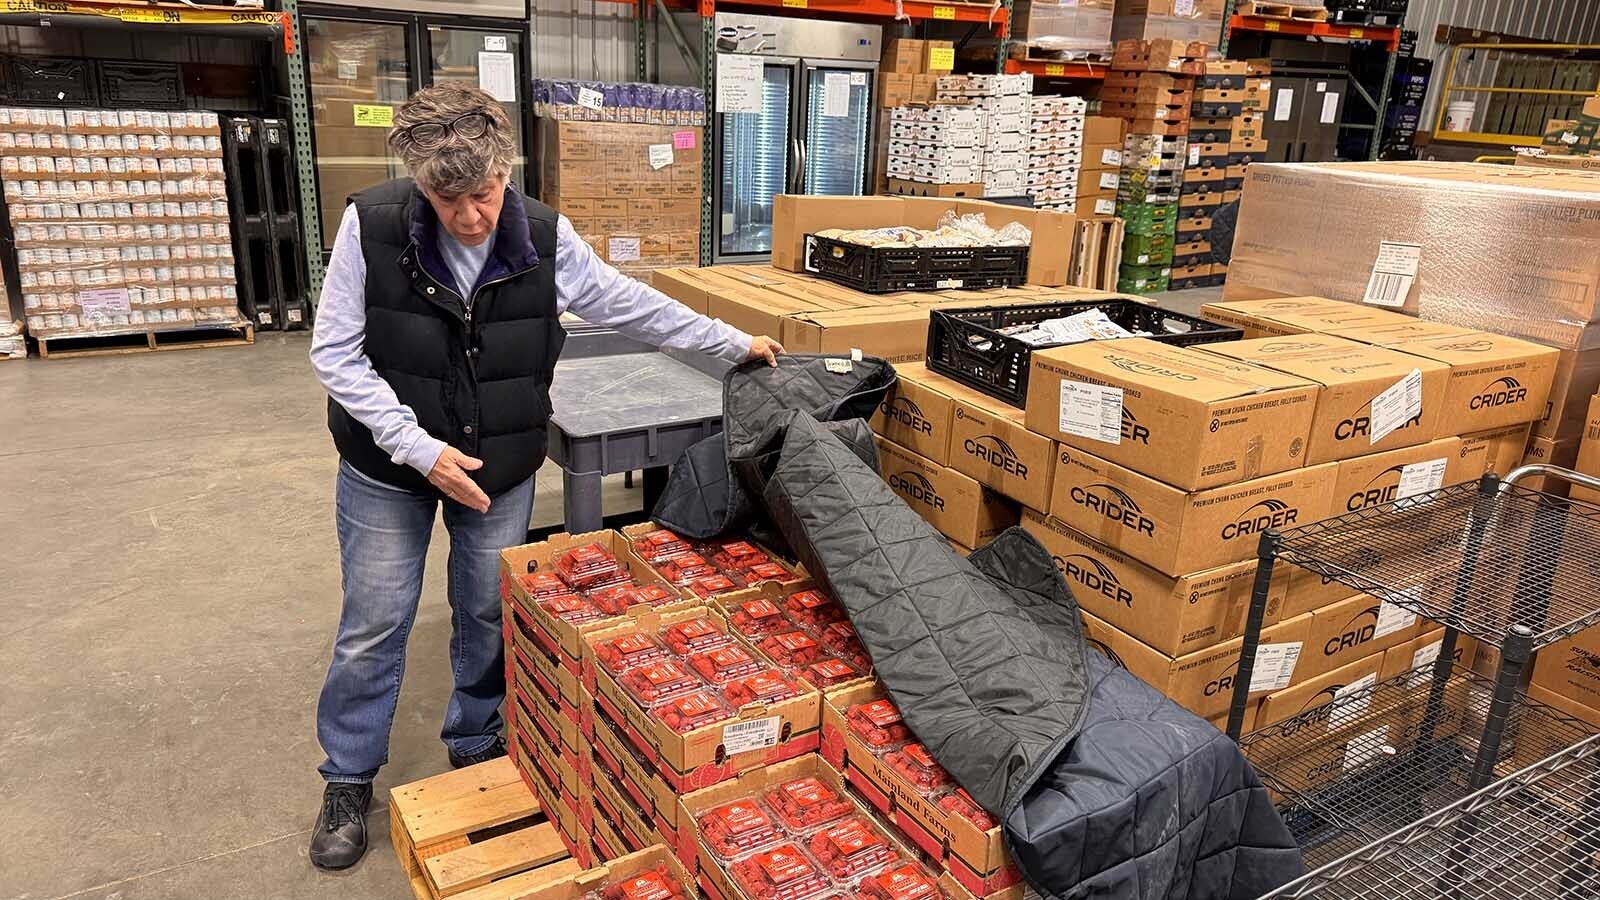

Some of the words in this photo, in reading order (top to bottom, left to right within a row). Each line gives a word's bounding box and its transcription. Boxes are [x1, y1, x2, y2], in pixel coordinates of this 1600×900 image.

[1035, 361, 1054, 373] PREMIUM
[1211, 407, 1232, 417] PREMIUM
[1470, 388, 1527, 410] CRIDER
[880, 401, 932, 436] CRIDER
[964, 439, 1028, 480] CRIDER
[889, 474, 945, 512] CRIDER
[1192, 498, 1214, 508] PREMIUM
[1347, 484, 1399, 511] CRID
[1070, 486, 1155, 538] CRIDER
[1221, 508, 1298, 540] CRIDER
[1052, 555, 1134, 608] CRIDER
[1324, 624, 1376, 657] CRID
[1203, 674, 1237, 697] CRI
[872, 764, 920, 813] Mainland
[922, 807, 957, 844] Farms
